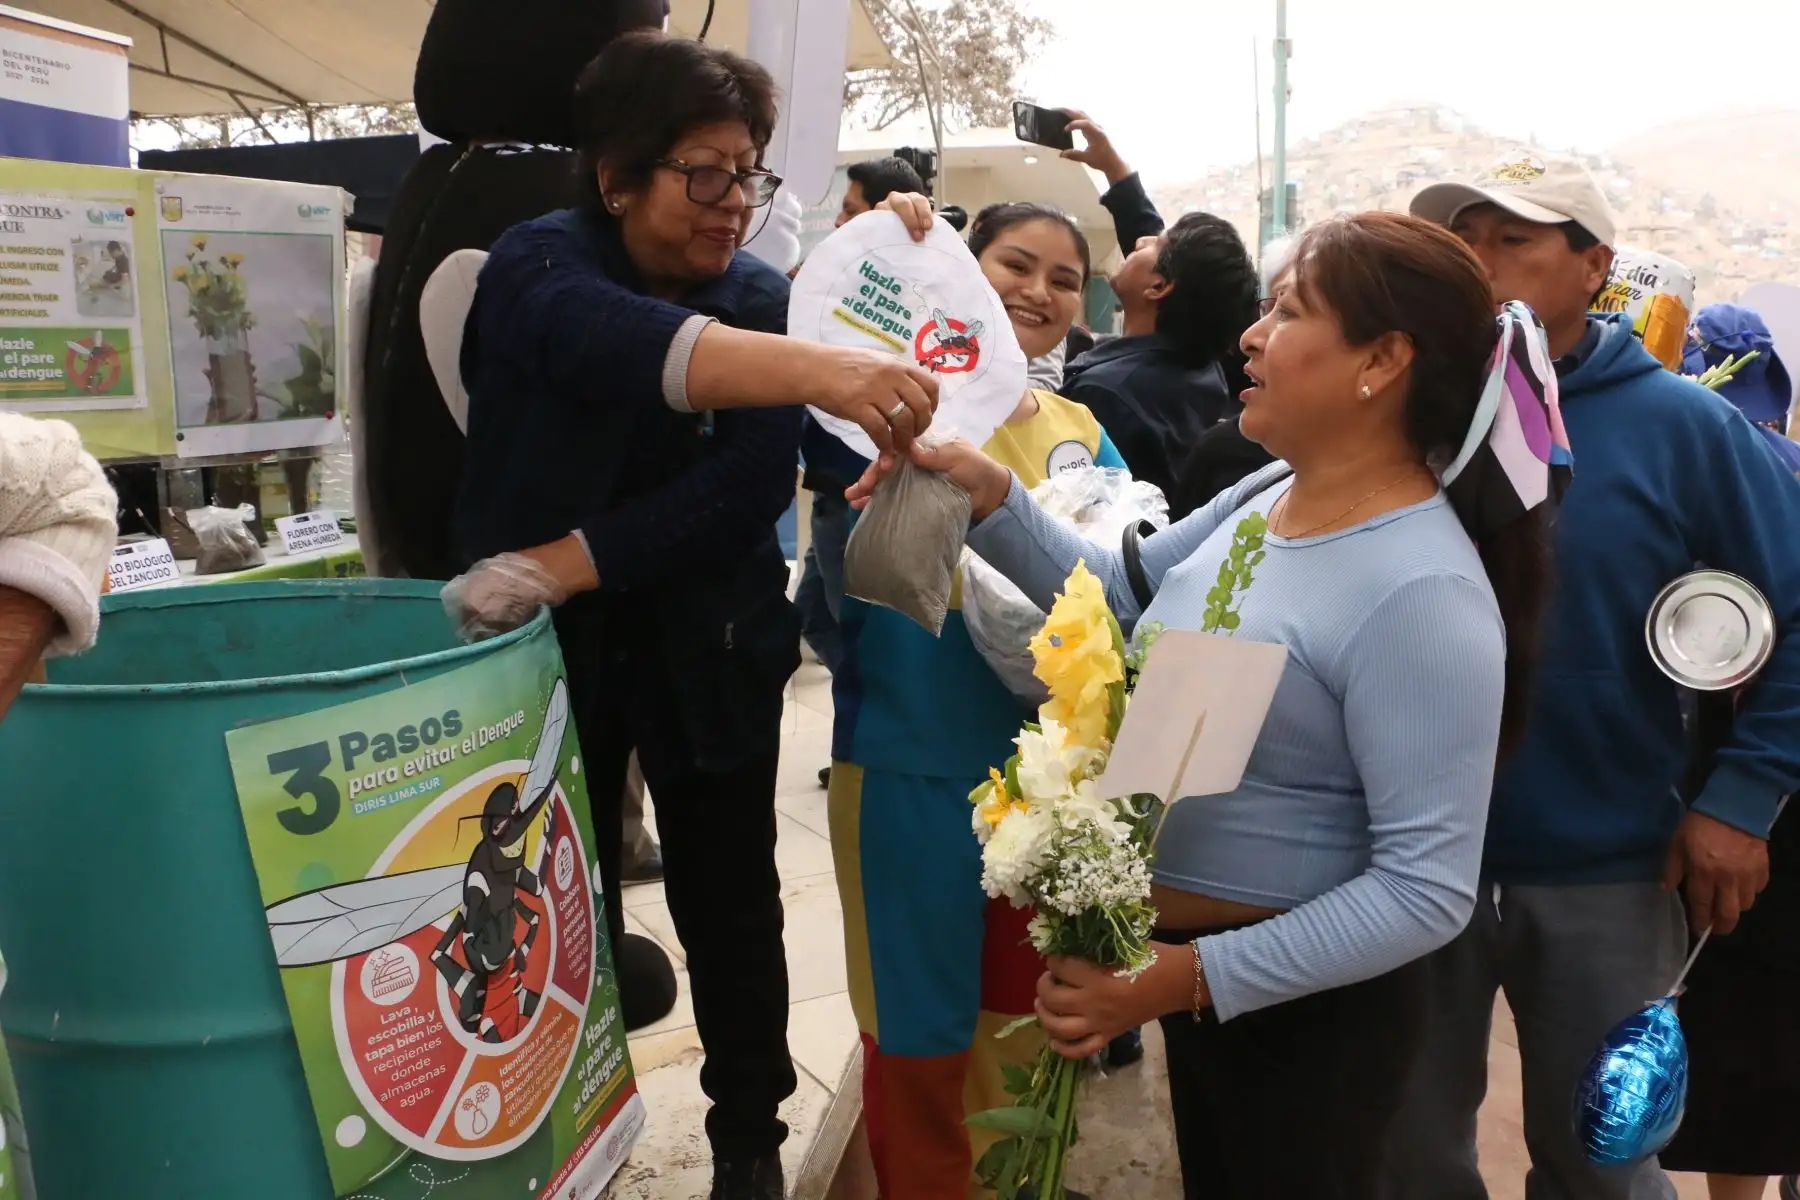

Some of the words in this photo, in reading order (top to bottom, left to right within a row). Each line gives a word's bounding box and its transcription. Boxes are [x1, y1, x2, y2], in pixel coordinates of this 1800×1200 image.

[2, 48, 71, 71] BICENTENARIO
[3, 60, 22, 70] DEL
[859, 260, 902, 295] Hazle
[841, 297, 854, 307] al
[853, 300, 913, 341] dengue
[860, 284, 877, 300] el
[873, 294, 912, 320] pare
[4, 351, 18, 364] el
[21, 354, 55, 366] pare
[8, 366, 63, 380] dengue
[287, 526, 319, 540] FLORERO
[319, 523, 334, 533] CON
[289, 539, 313, 550] ARENA
[110, 577, 127, 588] DEL
[126, 567, 171, 584] ZANCUDO
[339, 709, 463, 772] Pasos
[349, 766, 399, 800] para
[403, 744, 458, 777] evitar
[461, 730, 476, 755] el
[478, 709, 525, 749] Dengue
[266, 740, 341, 835] 3
[355, 795, 387, 814] DIRIS
[388, 786, 418, 802] LIMA
[419, 777, 441, 793] SUR
[367, 1015, 426, 1045] escobilla
[427, 1009, 435, 1022] y
[381, 1006, 411, 1025] Lava
[585, 1005, 616, 1048] Hazle
[364, 1043, 395, 1062] tapa
[396, 1030, 425, 1049] bien
[426, 1022, 443, 1035] los
[373, 1037, 442, 1074] recipientes
[500, 1041, 535, 1077] Identifica
[578, 1064, 586, 1081] el
[586, 1035, 612, 1077] pare
[380, 1064, 446, 1102] almacenas
[391, 1057, 431, 1082] donde
[502, 1077, 515, 1090] los
[504, 1070, 534, 1103] zancudo
[573, 1096, 582, 1114] al
[581, 1046, 623, 1102] dengue
[400, 1087, 434, 1108] agua.
[552, 1169, 568, 1192] gratis
[583, 1124, 601, 1150] SALUD
